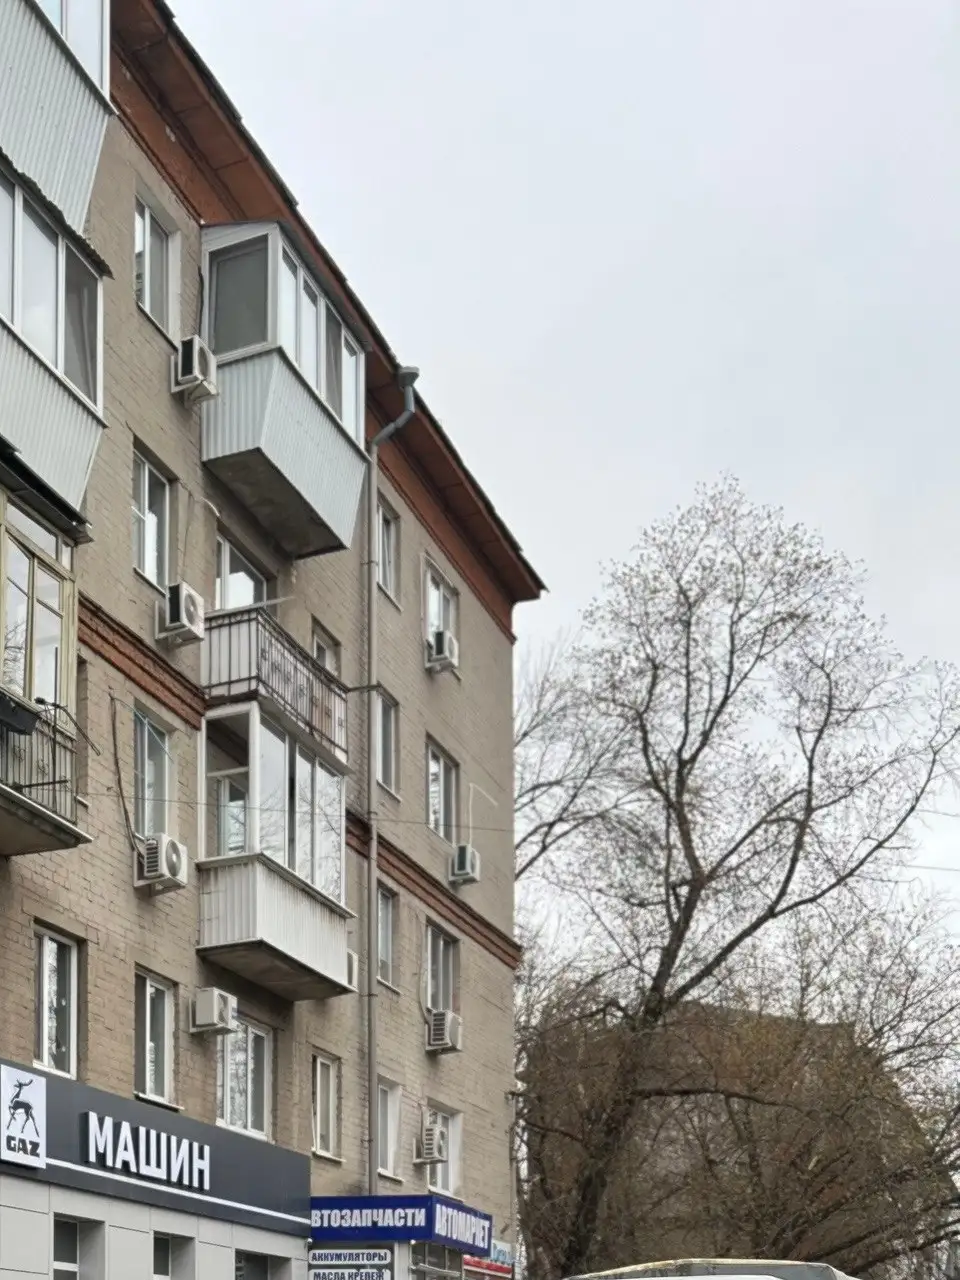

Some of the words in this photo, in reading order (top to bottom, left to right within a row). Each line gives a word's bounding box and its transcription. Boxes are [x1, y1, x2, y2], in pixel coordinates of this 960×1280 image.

[6, 1134, 40, 1158] GAZ
[87, 1111, 211, 1191] МАШИН
[435, 1203, 490, 1249] АВТОМАРКЕТ
[311, 1252, 388, 1262] АККУМУЛЯТОРЫ
[313, 1271, 346, 1280] МАСЛА
[347, 1271, 385, 1280] КРЕПЕЖ
